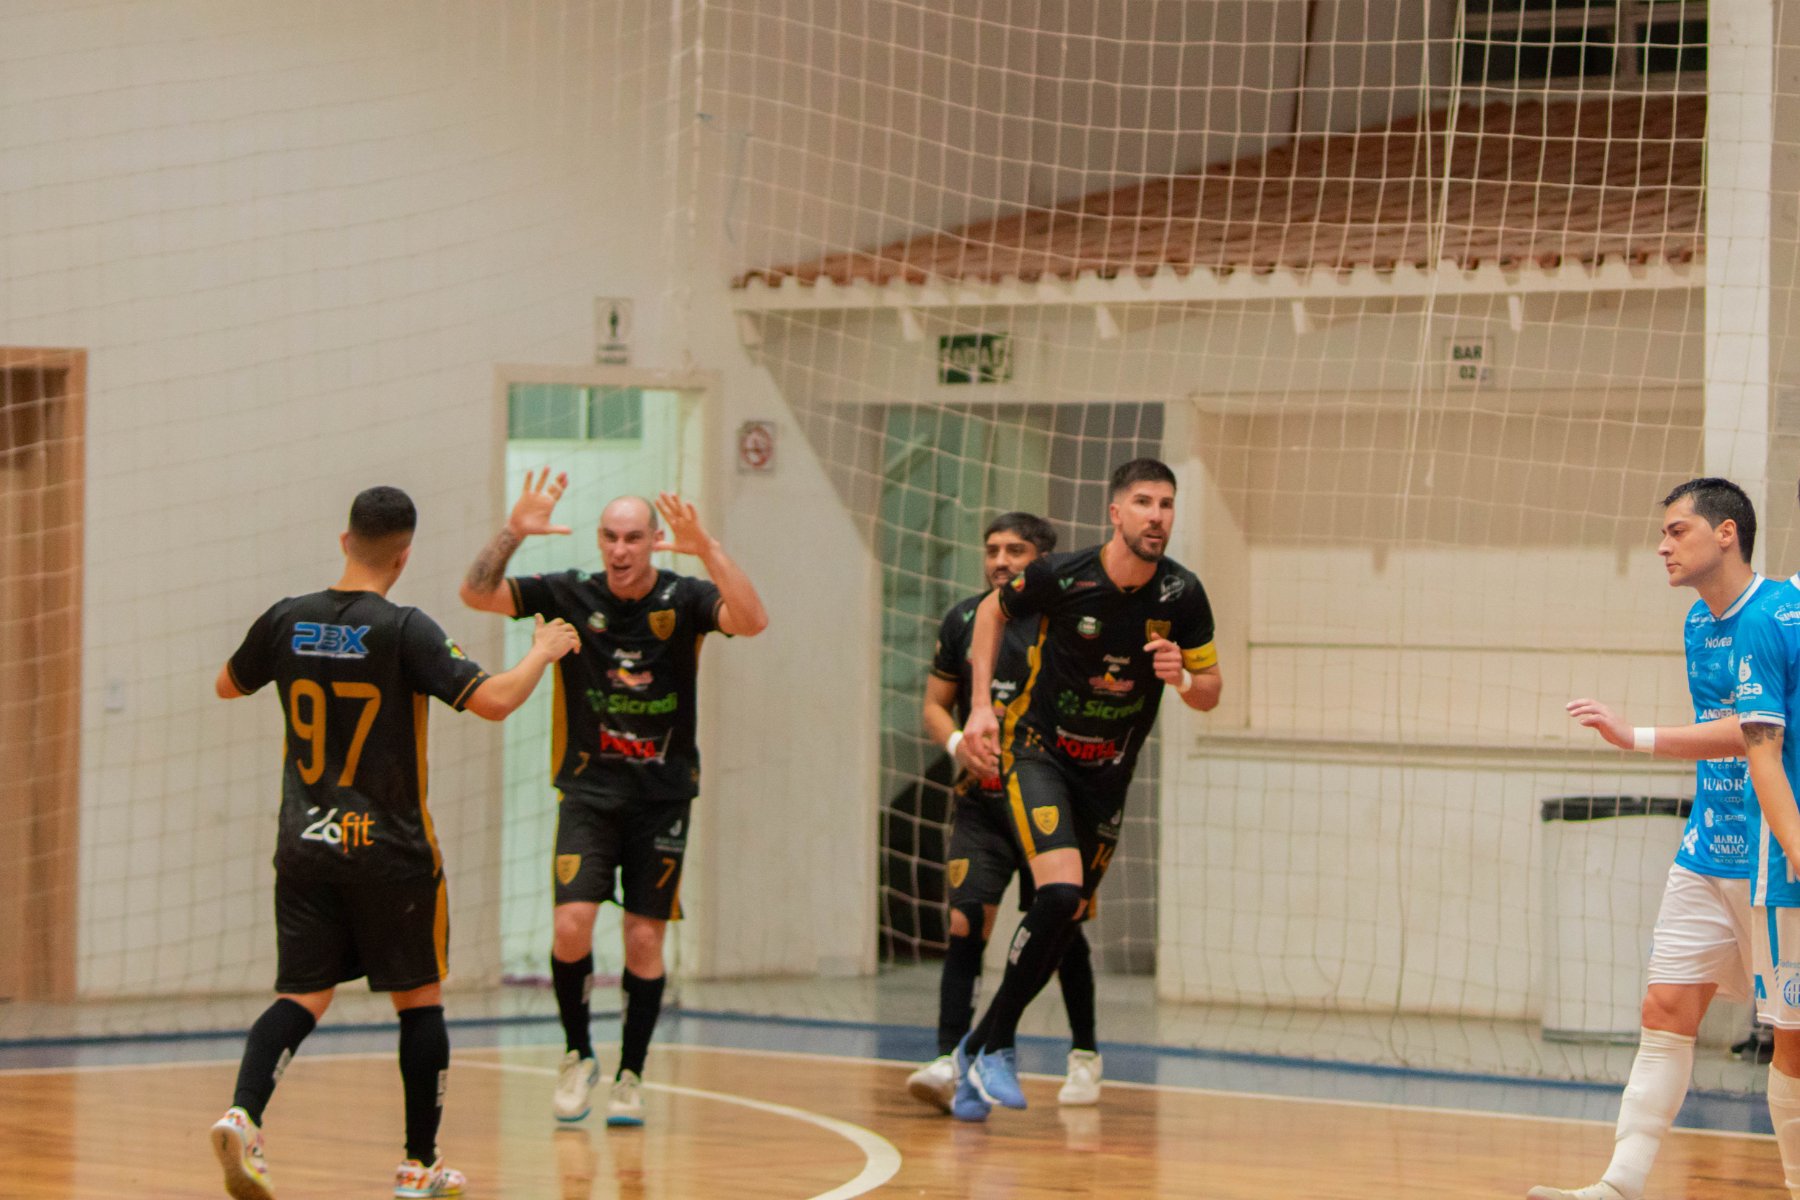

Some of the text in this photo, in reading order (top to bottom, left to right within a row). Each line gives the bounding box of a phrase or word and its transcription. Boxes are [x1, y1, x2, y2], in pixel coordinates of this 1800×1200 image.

[1453, 346, 1483, 360] BAR
[1460, 365, 1477, 379] 02
[288, 678, 382, 787] 97
[1713, 834, 1745, 844] MARIA
[656, 857, 677, 890] 7
